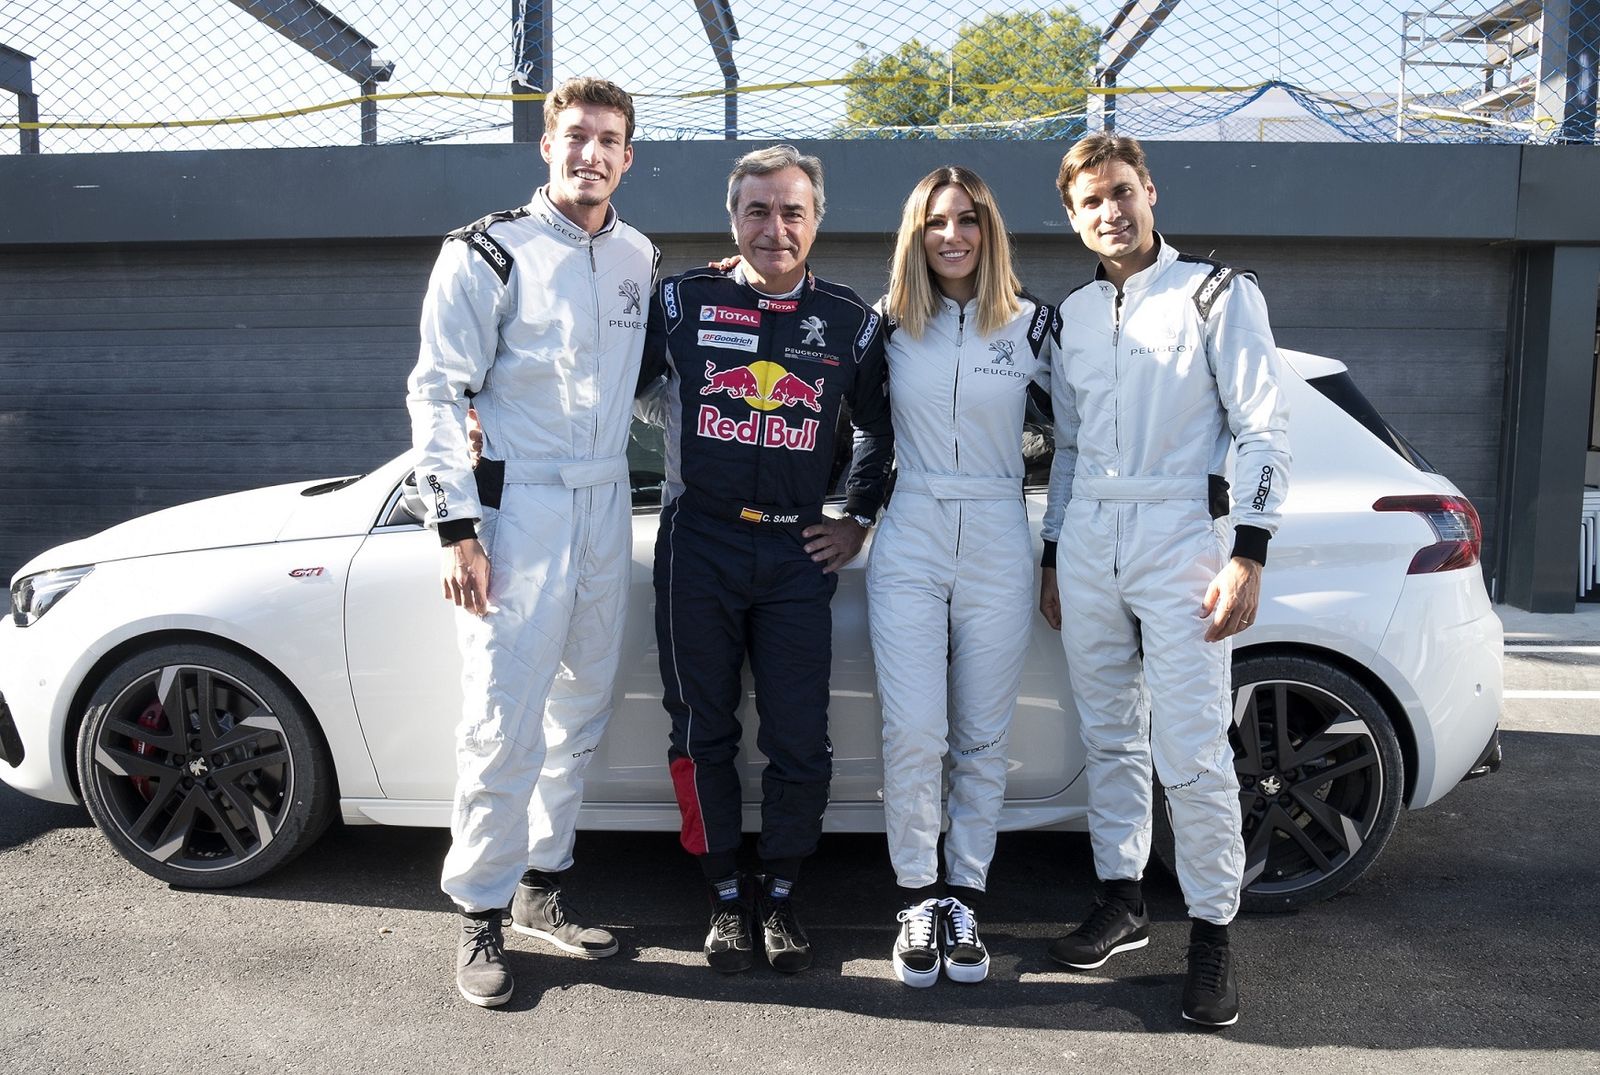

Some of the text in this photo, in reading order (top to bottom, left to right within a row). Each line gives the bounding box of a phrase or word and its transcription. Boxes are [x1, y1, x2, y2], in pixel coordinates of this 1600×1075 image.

[472, 233, 507, 267] sparco
[718, 309, 759, 324] TOTAL
[770, 302, 796, 311] TOTAL
[858, 313, 879, 349] sparco
[1032, 305, 1049, 341] sparco
[702, 333, 753, 346] BFGoodrich
[784, 347, 823, 358] PEUGEOT
[974, 367, 1027, 379] PEUGEOT
[697, 404, 819, 451] Red Bull
[426, 474, 449, 518] sparco
[1251, 465, 1274, 512] sparco
[762, 514, 799, 523] C. SAINZ
